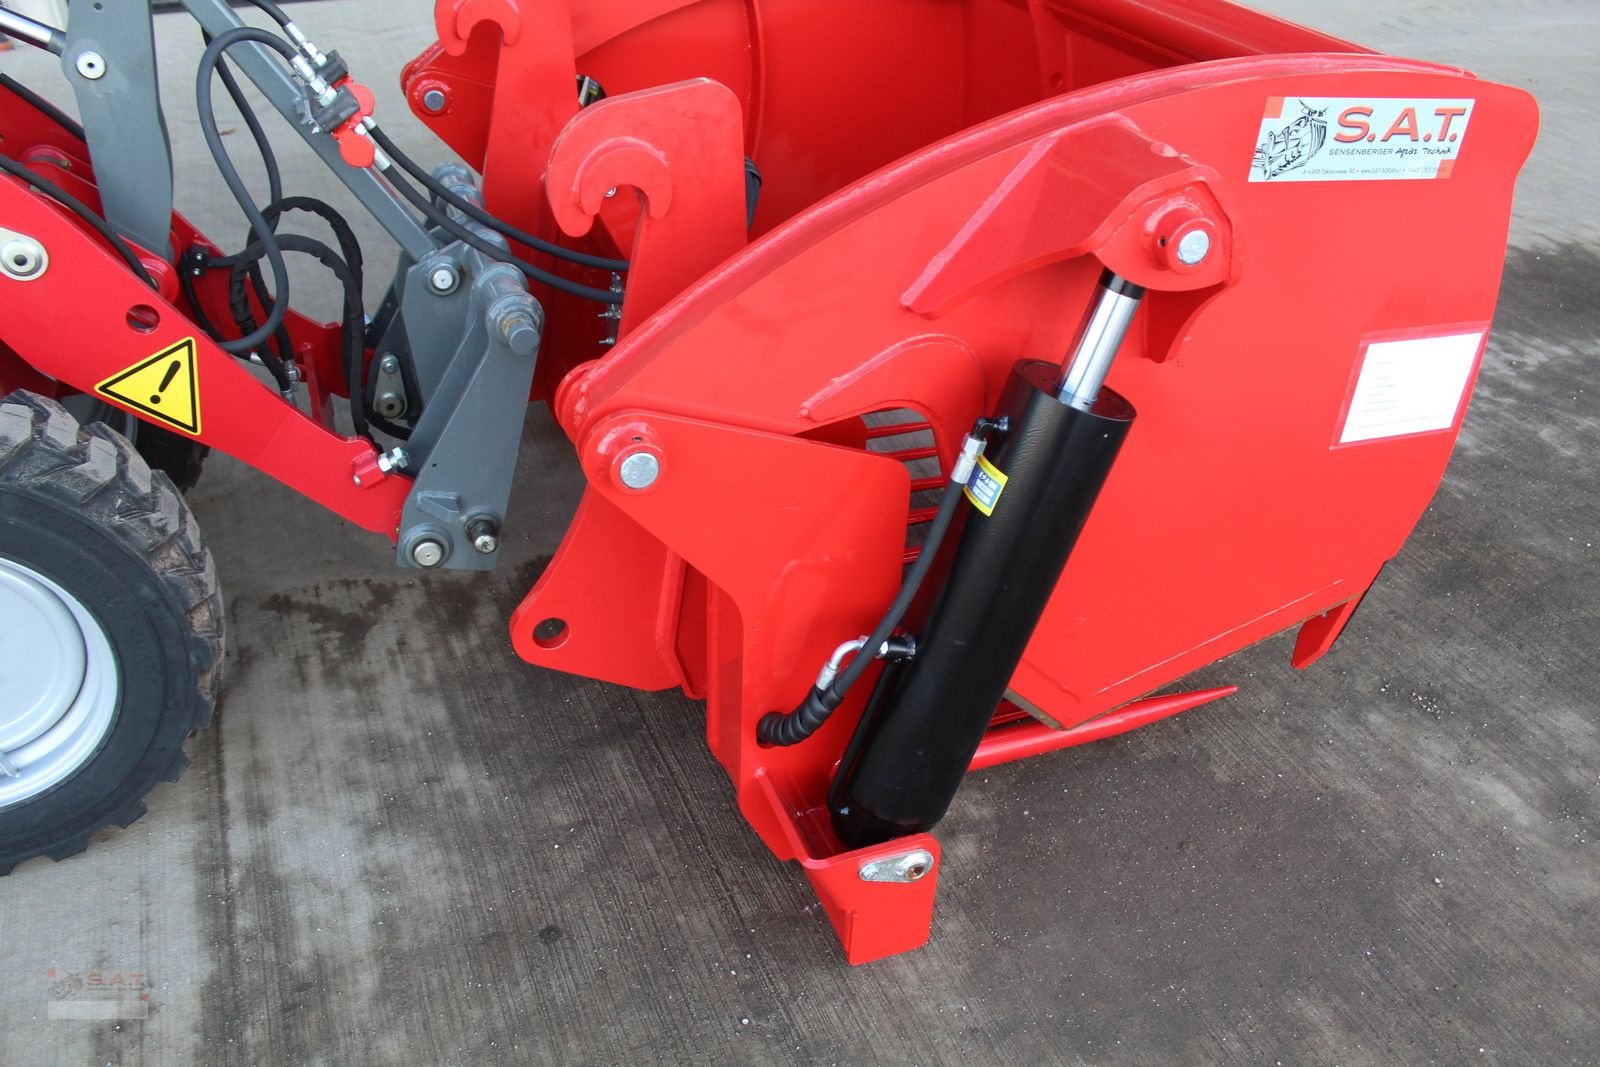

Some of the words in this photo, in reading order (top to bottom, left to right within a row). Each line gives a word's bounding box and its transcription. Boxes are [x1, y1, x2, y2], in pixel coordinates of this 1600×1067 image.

[1333, 105, 1467, 144] S.A.T.
[1328, 148, 1394, 156] SENSENBERGER
[1422, 146, 1453, 155] Technik
